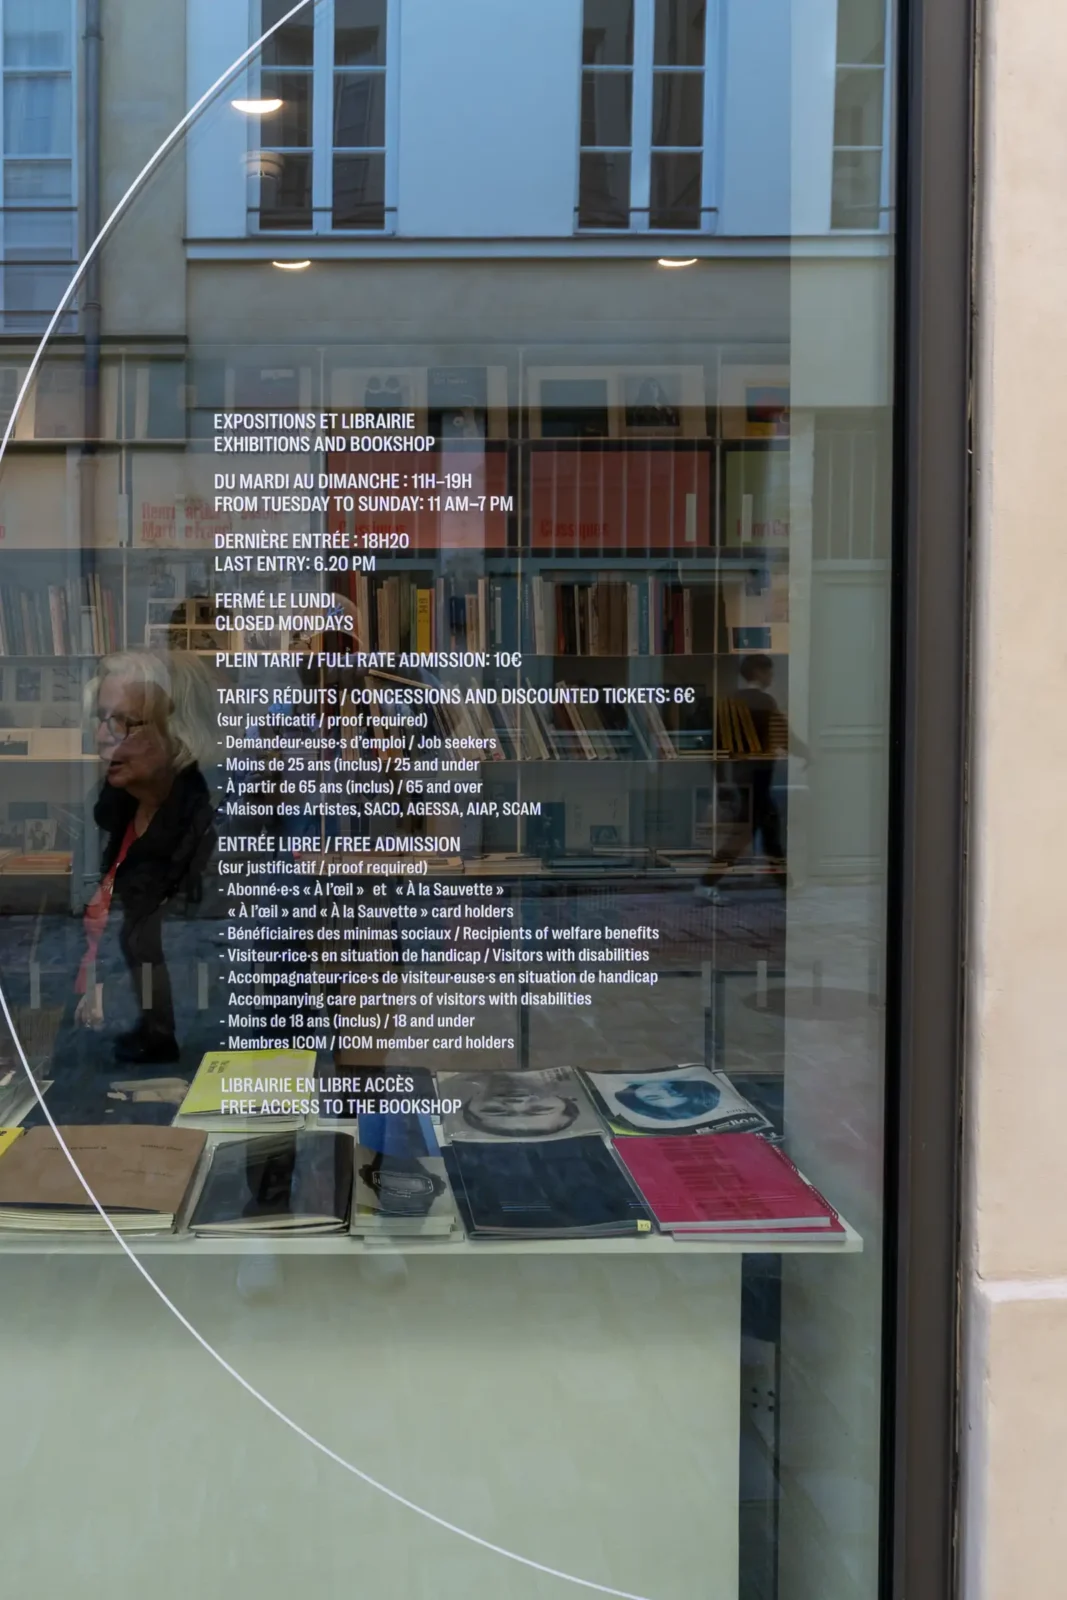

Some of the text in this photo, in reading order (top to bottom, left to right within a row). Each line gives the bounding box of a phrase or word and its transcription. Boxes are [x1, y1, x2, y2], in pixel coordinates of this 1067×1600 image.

[214, 413, 415, 429] EXPOSITIONS ET LIBRAIRIE
[215, 436, 434, 451] EXHIBITIONS AND BOOKSHOP
[215, 474, 235, 489] DU
[240, 474, 289, 489] MARDI
[294, 474, 313, 489] AU
[319, 473, 399, 489] DIMANCHE
[215, 496, 257, 511] FROM
[262, 496, 330, 511] TUESDAY
[334, 496, 354, 511] TO
[359, 496, 423, 511] SUNDAY:
[428, 496, 440, 511] 11
[490, 496, 513, 511] PM
[215, 529, 288, 549] DERNIÈRE
[293, 531, 349, 548] ENTRÉE
[362, 533, 409, 548] 18H20
[216, 556, 374, 571] LAST ENTRY: 6.20 PM
[215, 590, 336, 608] FERMÉ LE LUNDI
[216, 615, 353, 631] CLOSED MONDAYS
[216, 652, 521, 667] PLEIN TARIF FULL RATE ADMISSION: 10€
[217, 686, 694, 704] TARIFS RÉDUITS CONCESSIONS AND DISCOUNTED TICKETS: 6€
[218, 713, 427, 729] (sur justificatif proof required)
[418, 736, 441, 748] Job
[445, 736, 496, 749] seekers
[226, 757, 480, 772] Moins de 25 ans (inclus) 25 and under
[226, 777, 483, 796] À partir de 65 ans (inclus) 65 and over
[227, 802, 541, 817] Maison des Artistes, SACD, AGESSA, AIAP, SCAM
[219, 834, 460, 852] ENTRÉE LIBRE FREE ADMISSION
[219, 861, 427, 876] (sur justificatif proof required)
[314, 880, 323, 896] À
[373, 883, 386, 895] et
[407, 880, 415, 896] À
[419, 883, 430, 896] la
[434, 883, 492, 896] Sauvette
[239, 902, 248, 917] À
[293, 905, 316, 918] and
[331, 902, 340, 918] À
[343, 905, 354, 918] la
[358, 905, 417, 918] Sauvette
[432, 905, 461, 918] card
[465, 905, 513, 917] holders
[228, 926, 659, 942] Bénéficiaires des minimas sociaux Recipients of welfare benefits
[322, 952, 337, 962] en
[341, 949, 398, 962] situation
[402, 949, 418, 962] de
[422, 949, 480, 964] handicap
[493, 949, 543, 961] Visitors
[546, 948, 575, 961] with
[579, 948, 649, 961] disabilities
[382, 971, 398, 983] de
[499, 973, 514, 983] en
[518, 970, 576, 983] situation
[580, 970, 595, 983] de
[599, 970, 658, 985] handicap
[229, 992, 591, 1008] Accompanying care partners of visitors with disabilities
[229, 1014, 475, 1029] Moins de 18 ans (inclus) 18 and under
[229, 1036, 514, 1049] Membres ICOM ICOM member card holders
[221, 1074, 414, 1093] LIBRAIRIE EN LIBRE ACCÈS
[221, 1098, 462, 1114] FREE ACCESS TO THE BOOKSHOP
